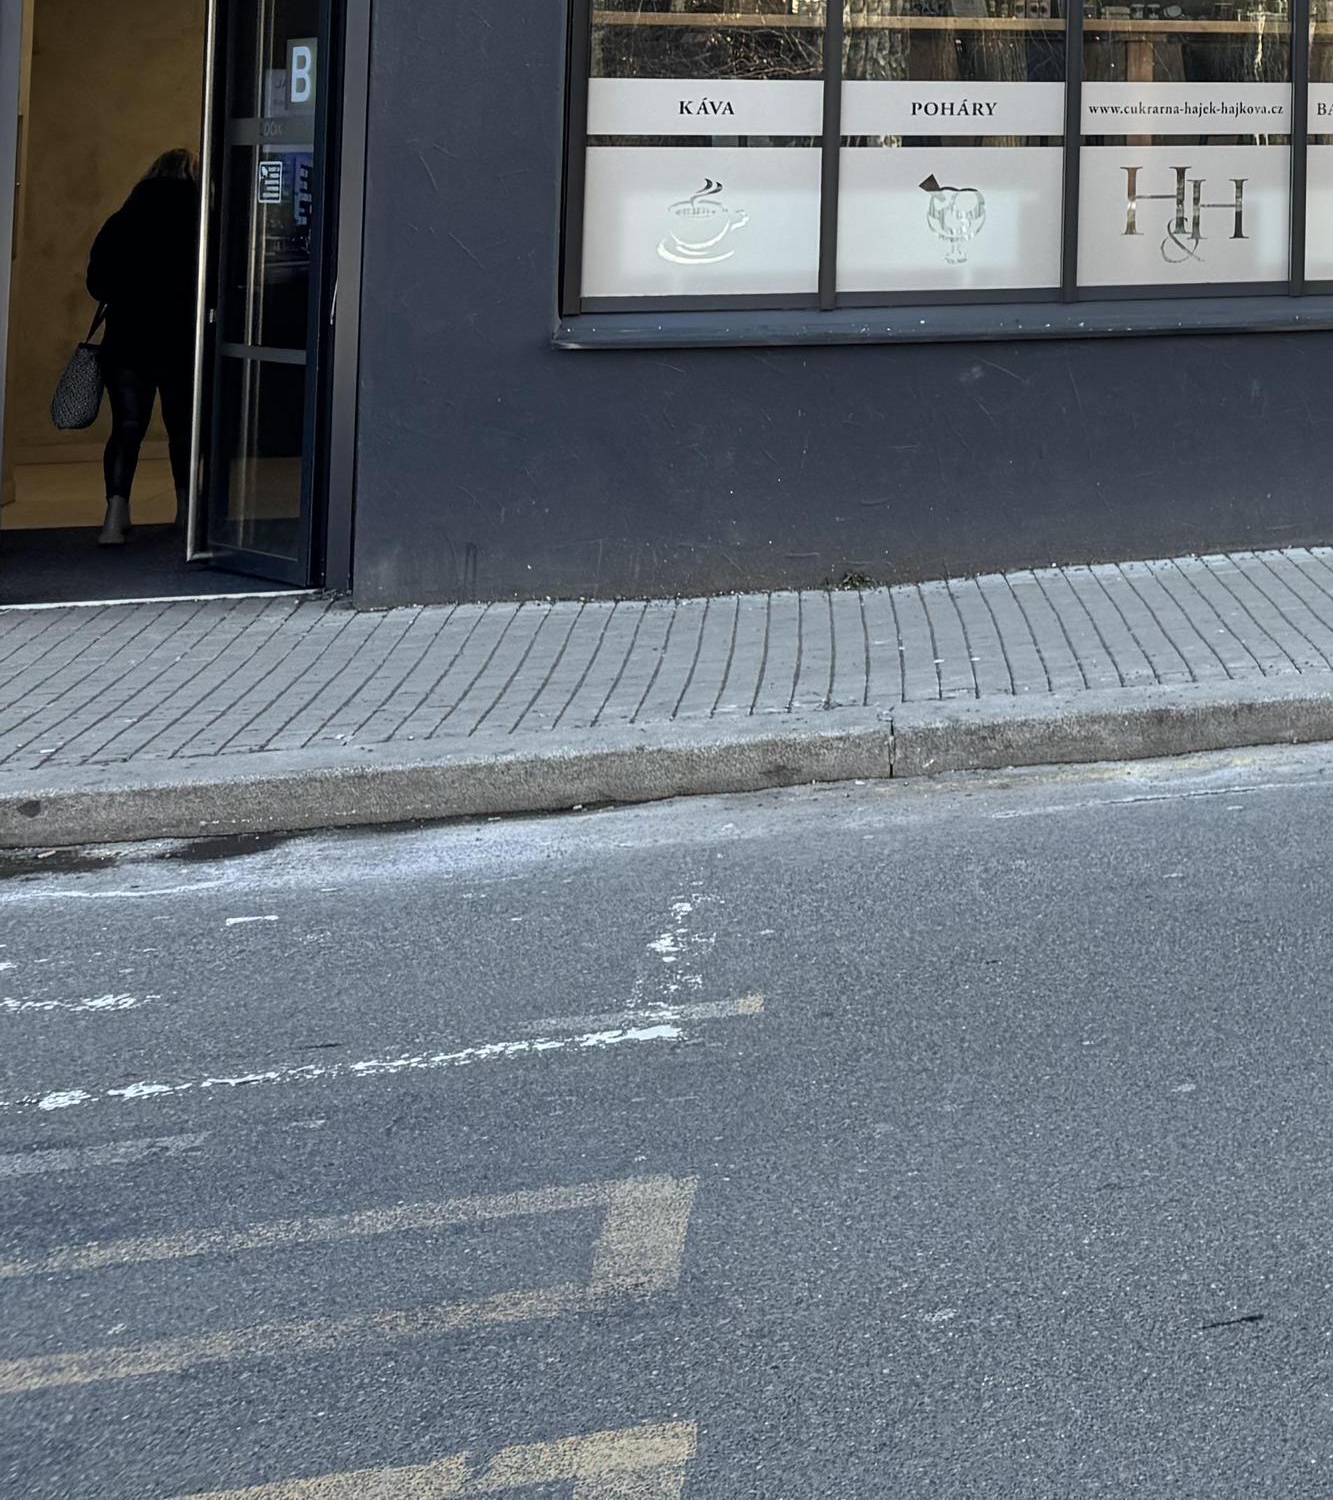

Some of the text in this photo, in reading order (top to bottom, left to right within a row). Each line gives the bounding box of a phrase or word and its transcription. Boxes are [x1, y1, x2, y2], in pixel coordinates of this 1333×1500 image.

[291, 46, 312, 103] B
[679, 97, 735, 115] KÁVA
[911, 99, 998, 117] POHÁRY
[1089, 102, 1284, 118] www.cukrarna-hajek-hajkova.cz
